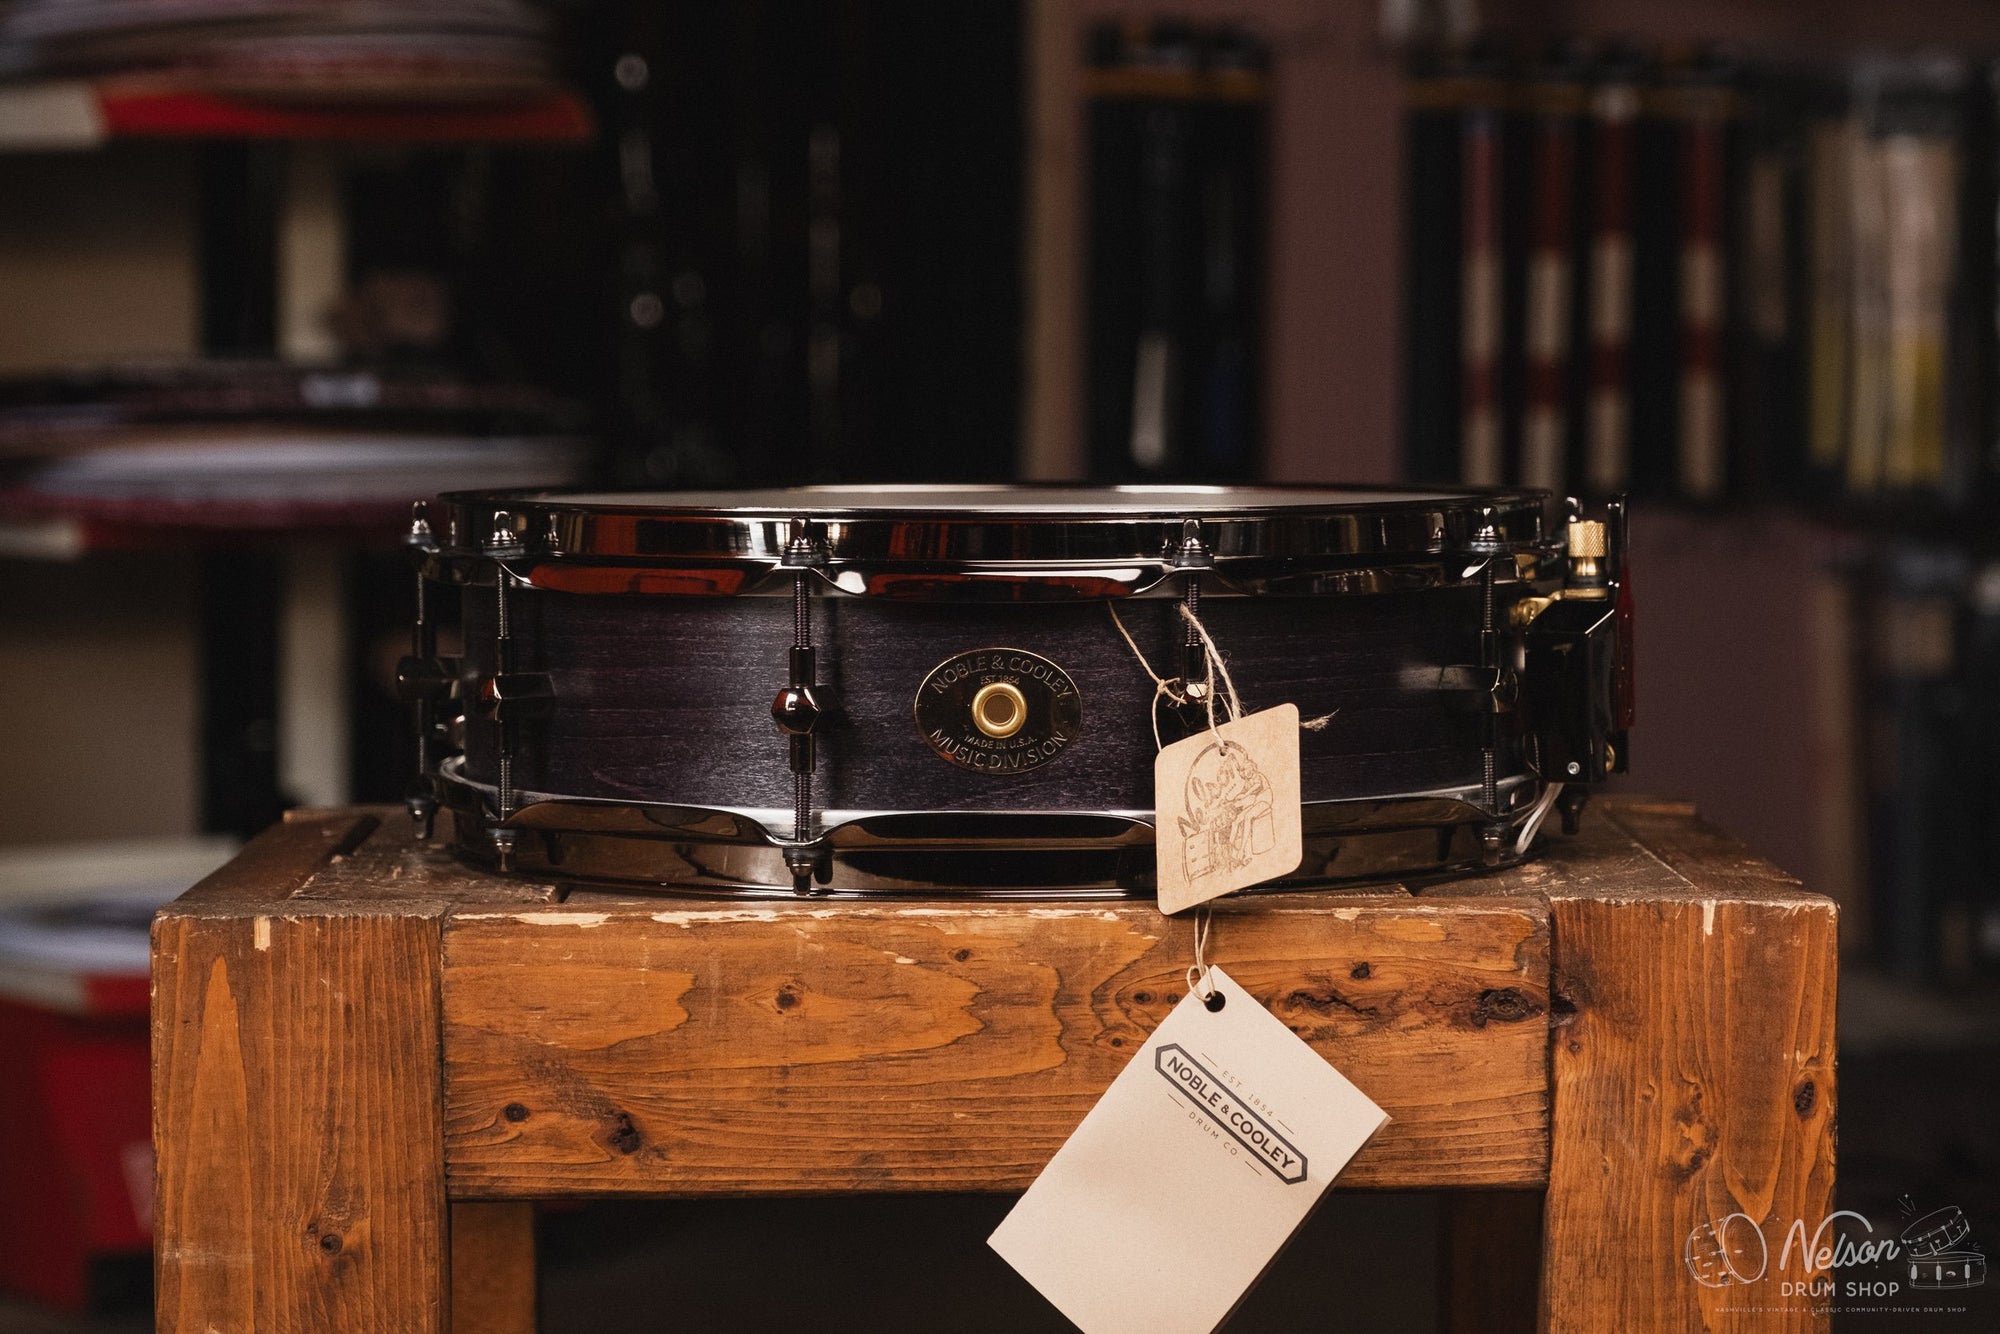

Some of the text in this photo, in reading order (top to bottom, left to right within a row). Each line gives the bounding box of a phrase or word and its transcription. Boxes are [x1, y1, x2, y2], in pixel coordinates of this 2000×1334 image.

[931, 655, 1073, 698] NOBLE & COOLEY
[930, 728, 1068, 769] MUSIC DIVISION
[964, 735, 1038, 750] MADE IN U.S.A.
[1167, 1056, 1296, 1169] NOBLE & COOLEY
[1248, 1093, 1273, 1117] 1854
[1189, 1111, 1219, 1140] DRUM
